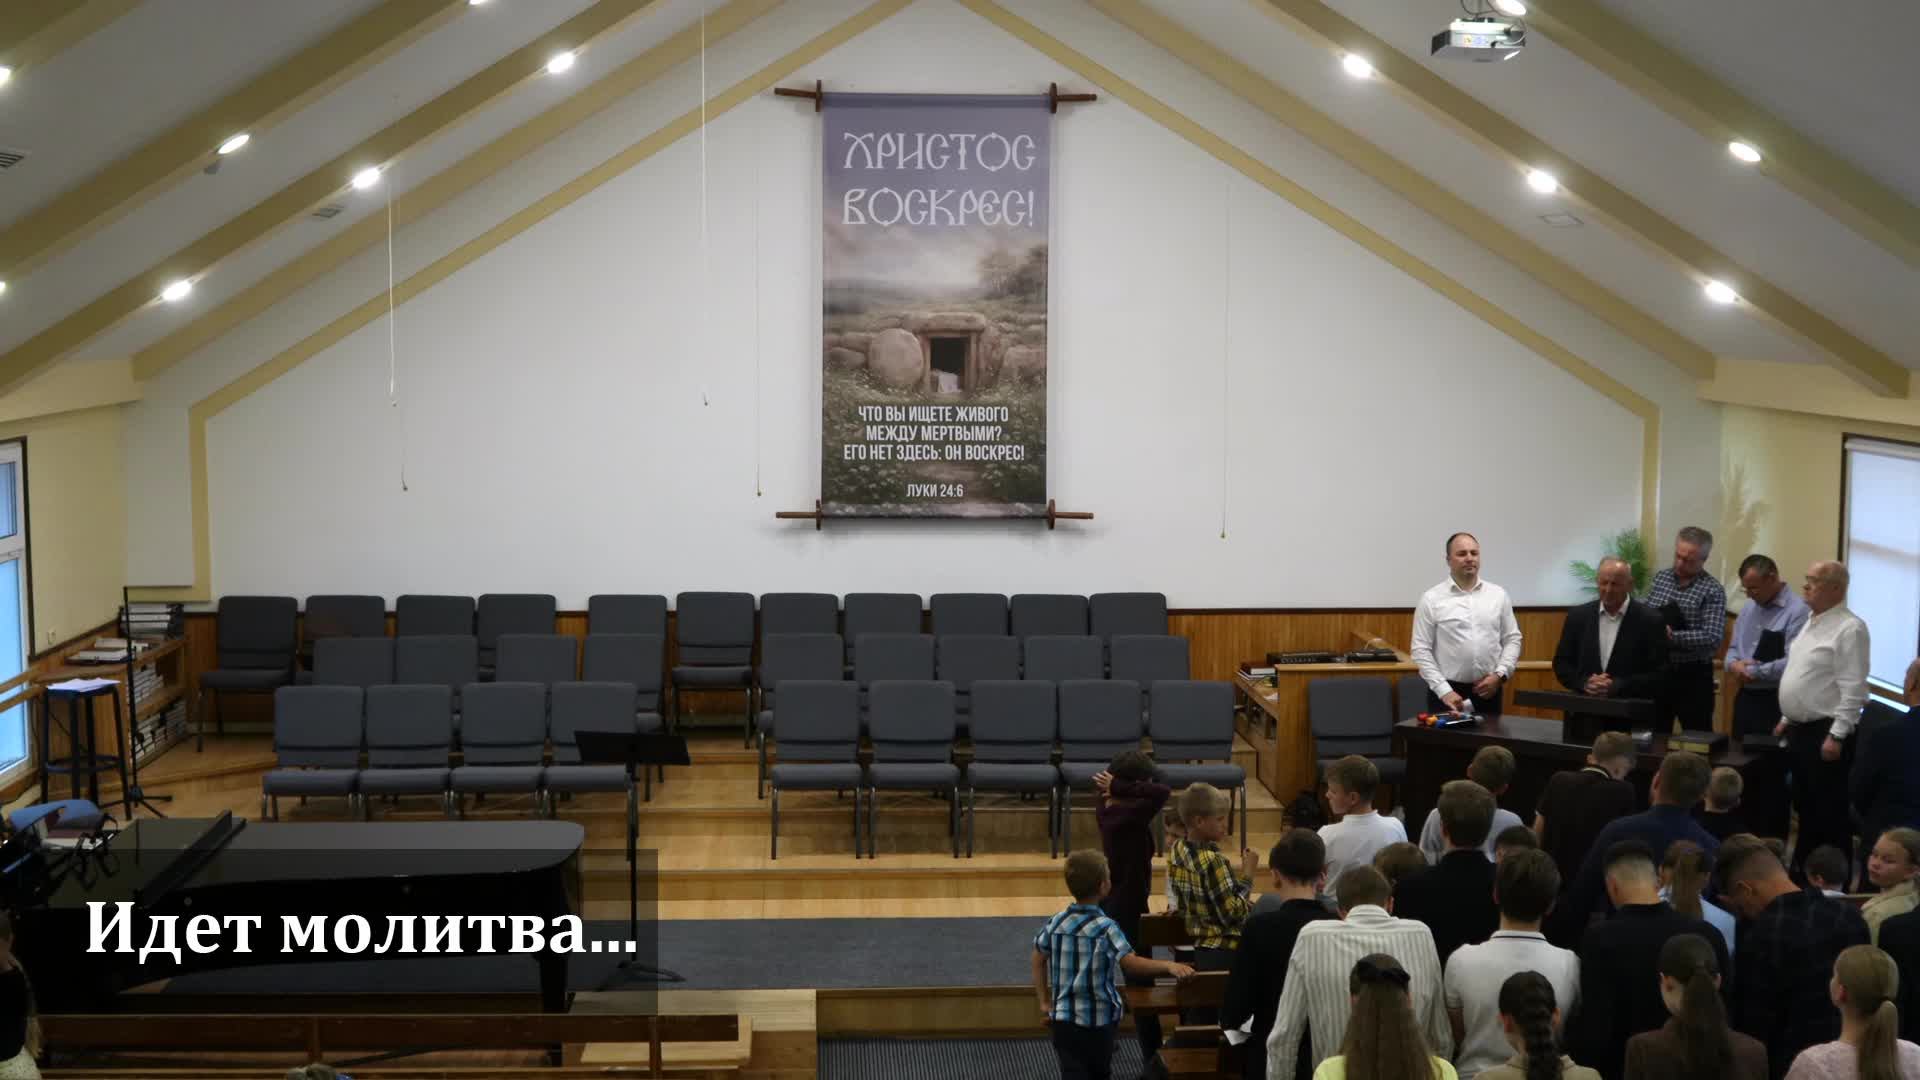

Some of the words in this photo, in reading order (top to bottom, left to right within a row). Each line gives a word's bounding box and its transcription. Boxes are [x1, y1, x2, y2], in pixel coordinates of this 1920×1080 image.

[843, 132, 1036, 172] ХРИСТОС
[841, 187, 1034, 227] ВОСКРЕС!
[858, 405, 883, 422] ЧТО
[885, 405, 906, 422] ВЫ
[908, 406, 952, 424] ИЩЕТЕ
[955, 406, 1009, 422] ЖИВОГО
[866, 425, 918, 443] МЕЖДУ
[921, 425, 1001, 441] МЕРТВЫМИ?
[844, 445, 866, 460] ЕГО
[869, 445, 893, 460] НЕТ
[896, 445, 942, 462] ЗДЕСЬ:
[945, 445, 962, 460] ОН
[965, 445, 1025, 460] ВОСКРЕС!
[906, 484, 938, 497] ЛУКИ
[940, 484, 964, 497] 24:6
